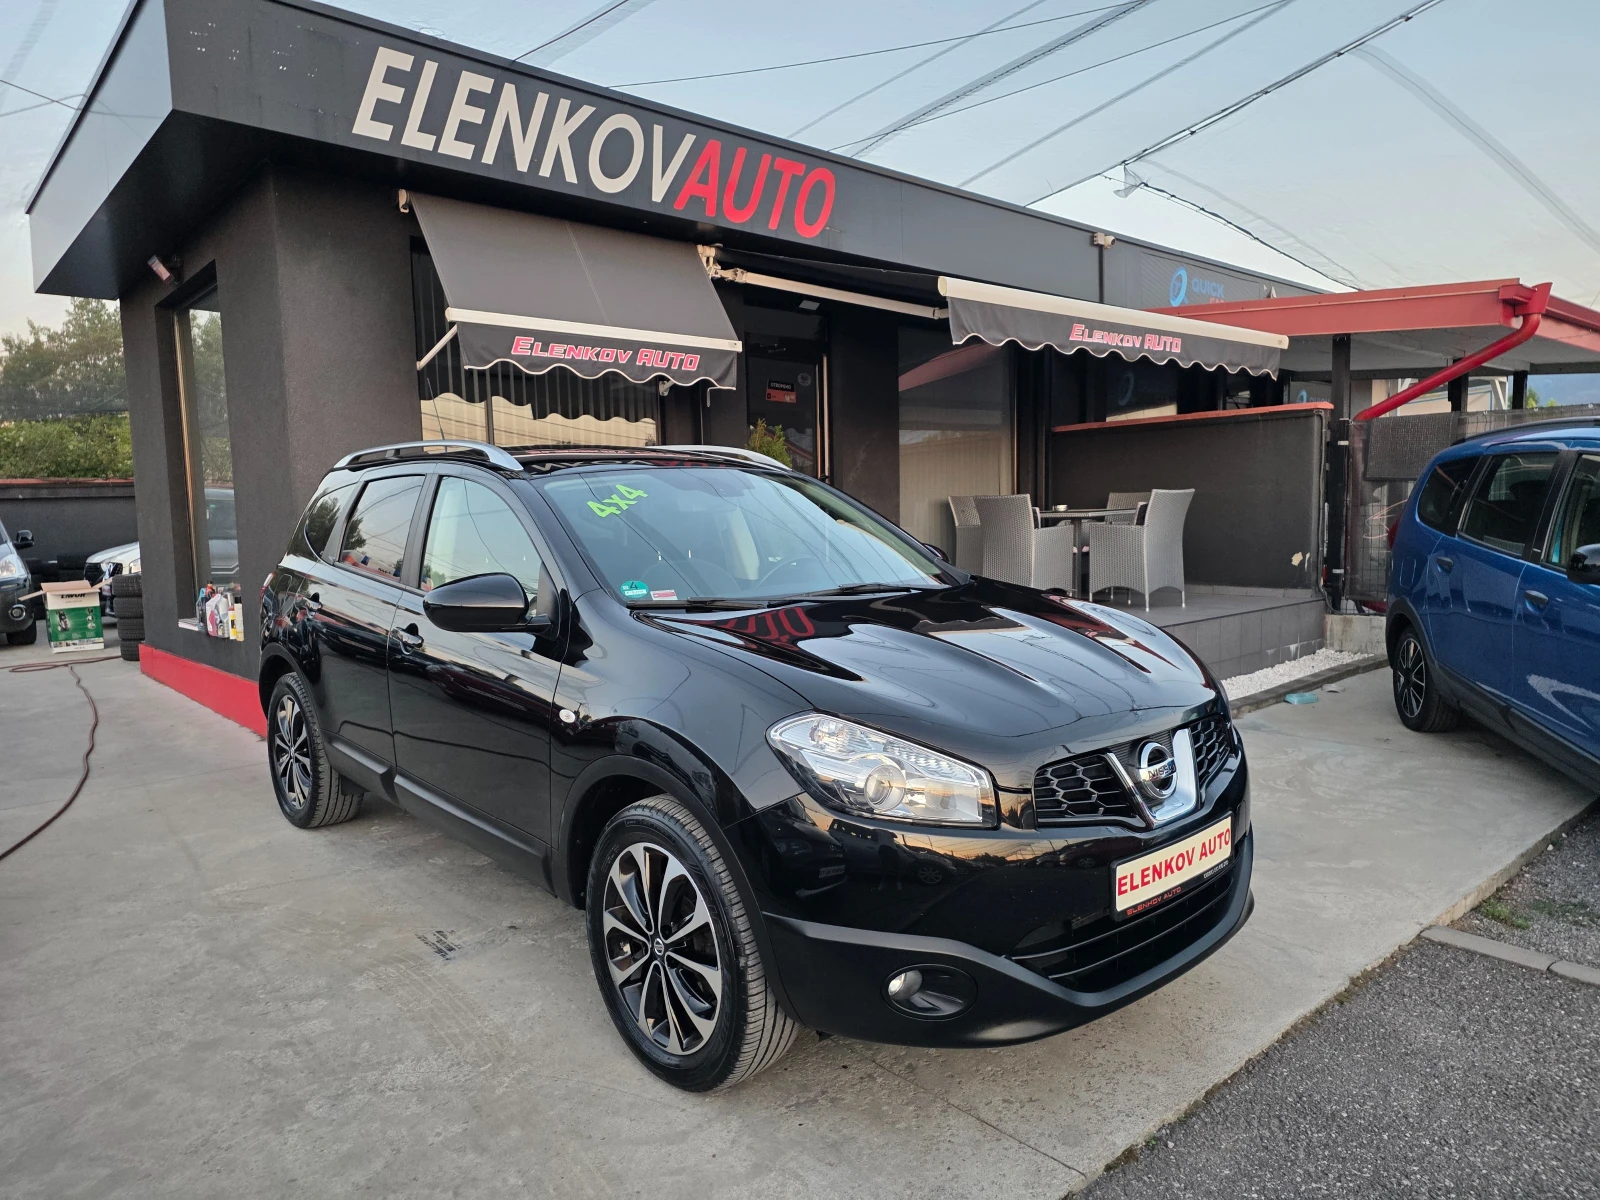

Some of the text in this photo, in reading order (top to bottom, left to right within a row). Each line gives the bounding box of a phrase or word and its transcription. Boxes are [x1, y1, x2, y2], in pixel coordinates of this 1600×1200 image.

[1191, 277, 1225, 299] QUICK
[1069, 323, 1182, 353] ELENKOV AUTO
[511, 336, 700, 371] ELENKOV AUTO
[1117, 846, 1195, 897] ELENKOV
[1199, 827, 1231, 861] AUTO
[1163, 886, 1182, 900] AUTO
